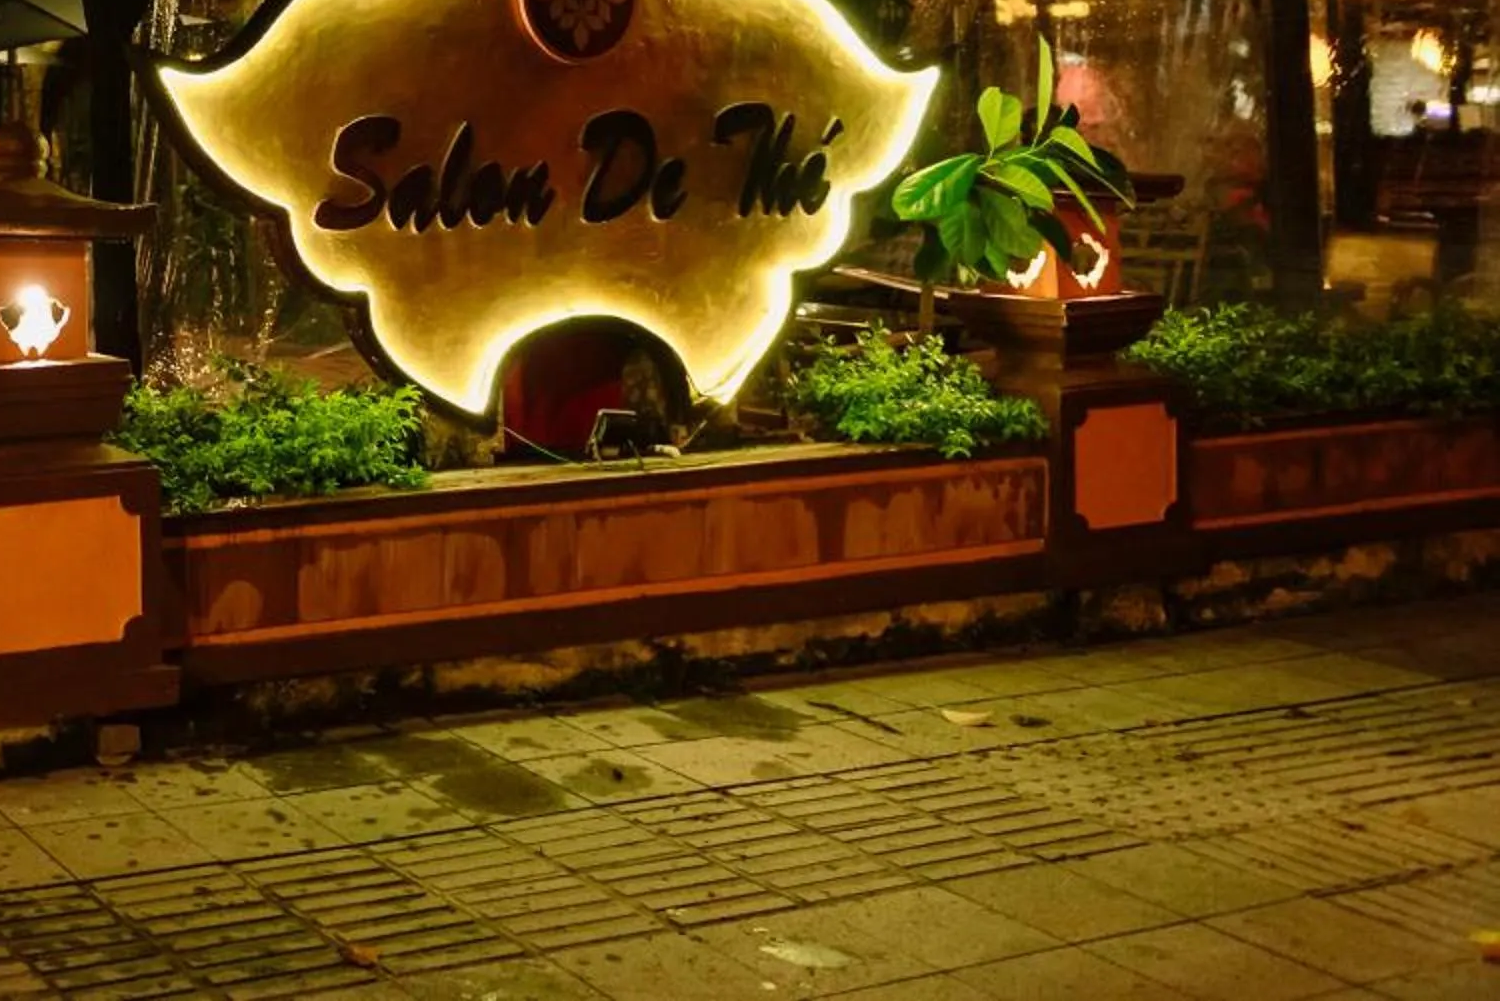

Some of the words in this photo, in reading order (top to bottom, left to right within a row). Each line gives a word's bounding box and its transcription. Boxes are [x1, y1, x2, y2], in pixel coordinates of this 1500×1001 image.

[311, 113, 557, 235] Salon
[578, 107, 687, 224] De
[710, 100, 845, 219] Thé
